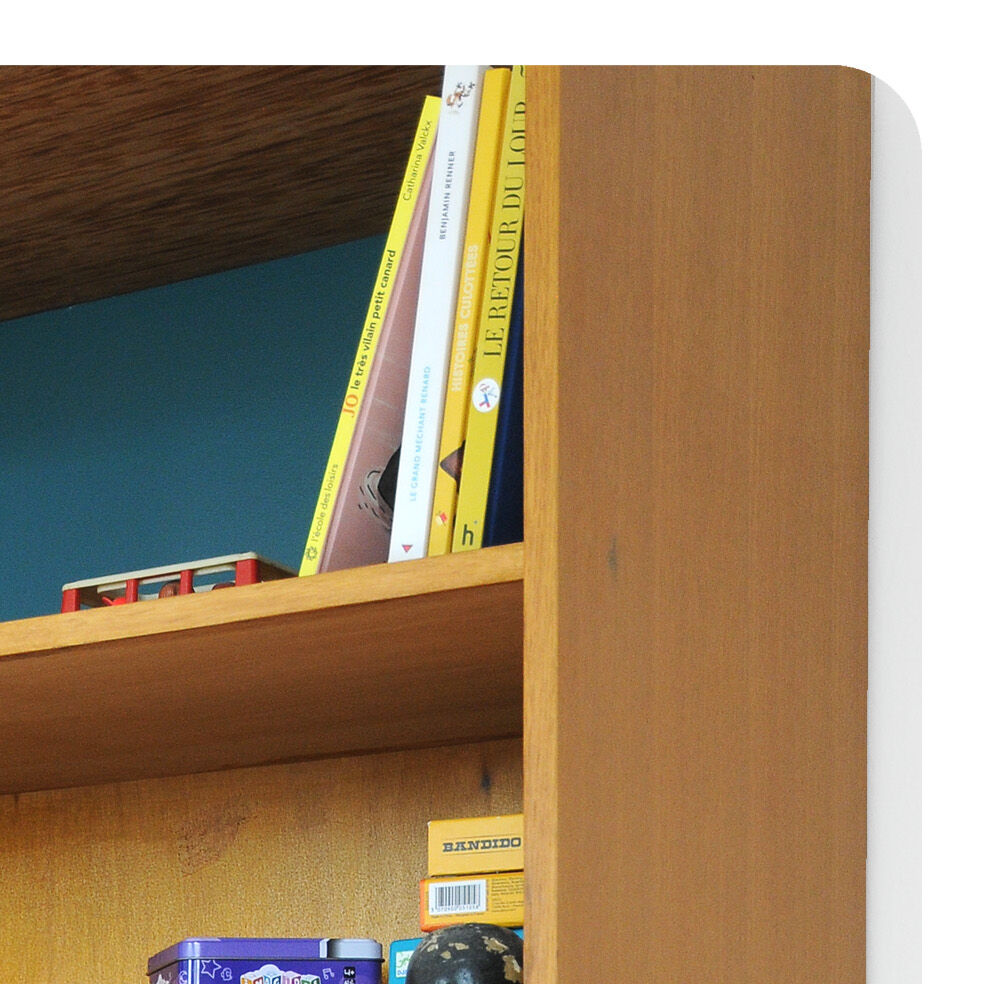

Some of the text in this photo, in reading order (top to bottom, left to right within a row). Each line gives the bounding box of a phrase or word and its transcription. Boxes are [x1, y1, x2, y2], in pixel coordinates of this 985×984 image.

[402, 120, 432, 201] Catharina Valckx
[439, 151, 455, 240] BENJAMIN RENNER
[502, 176, 524, 209] DU
[488, 219, 519, 319] RETOUR
[341, 249, 396, 418] JO le très vilain petit canard
[451, 323, 469, 392] HISTOIRES
[483, 327, 505, 356] LE
[420, 366, 431, 404] RENARD
[409, 492, 417, 502] LE
[410, 455, 421, 489] GRAND
[311, 463, 339, 543] l'école des loisirs
[442, 837, 522, 852] BANDIDO
